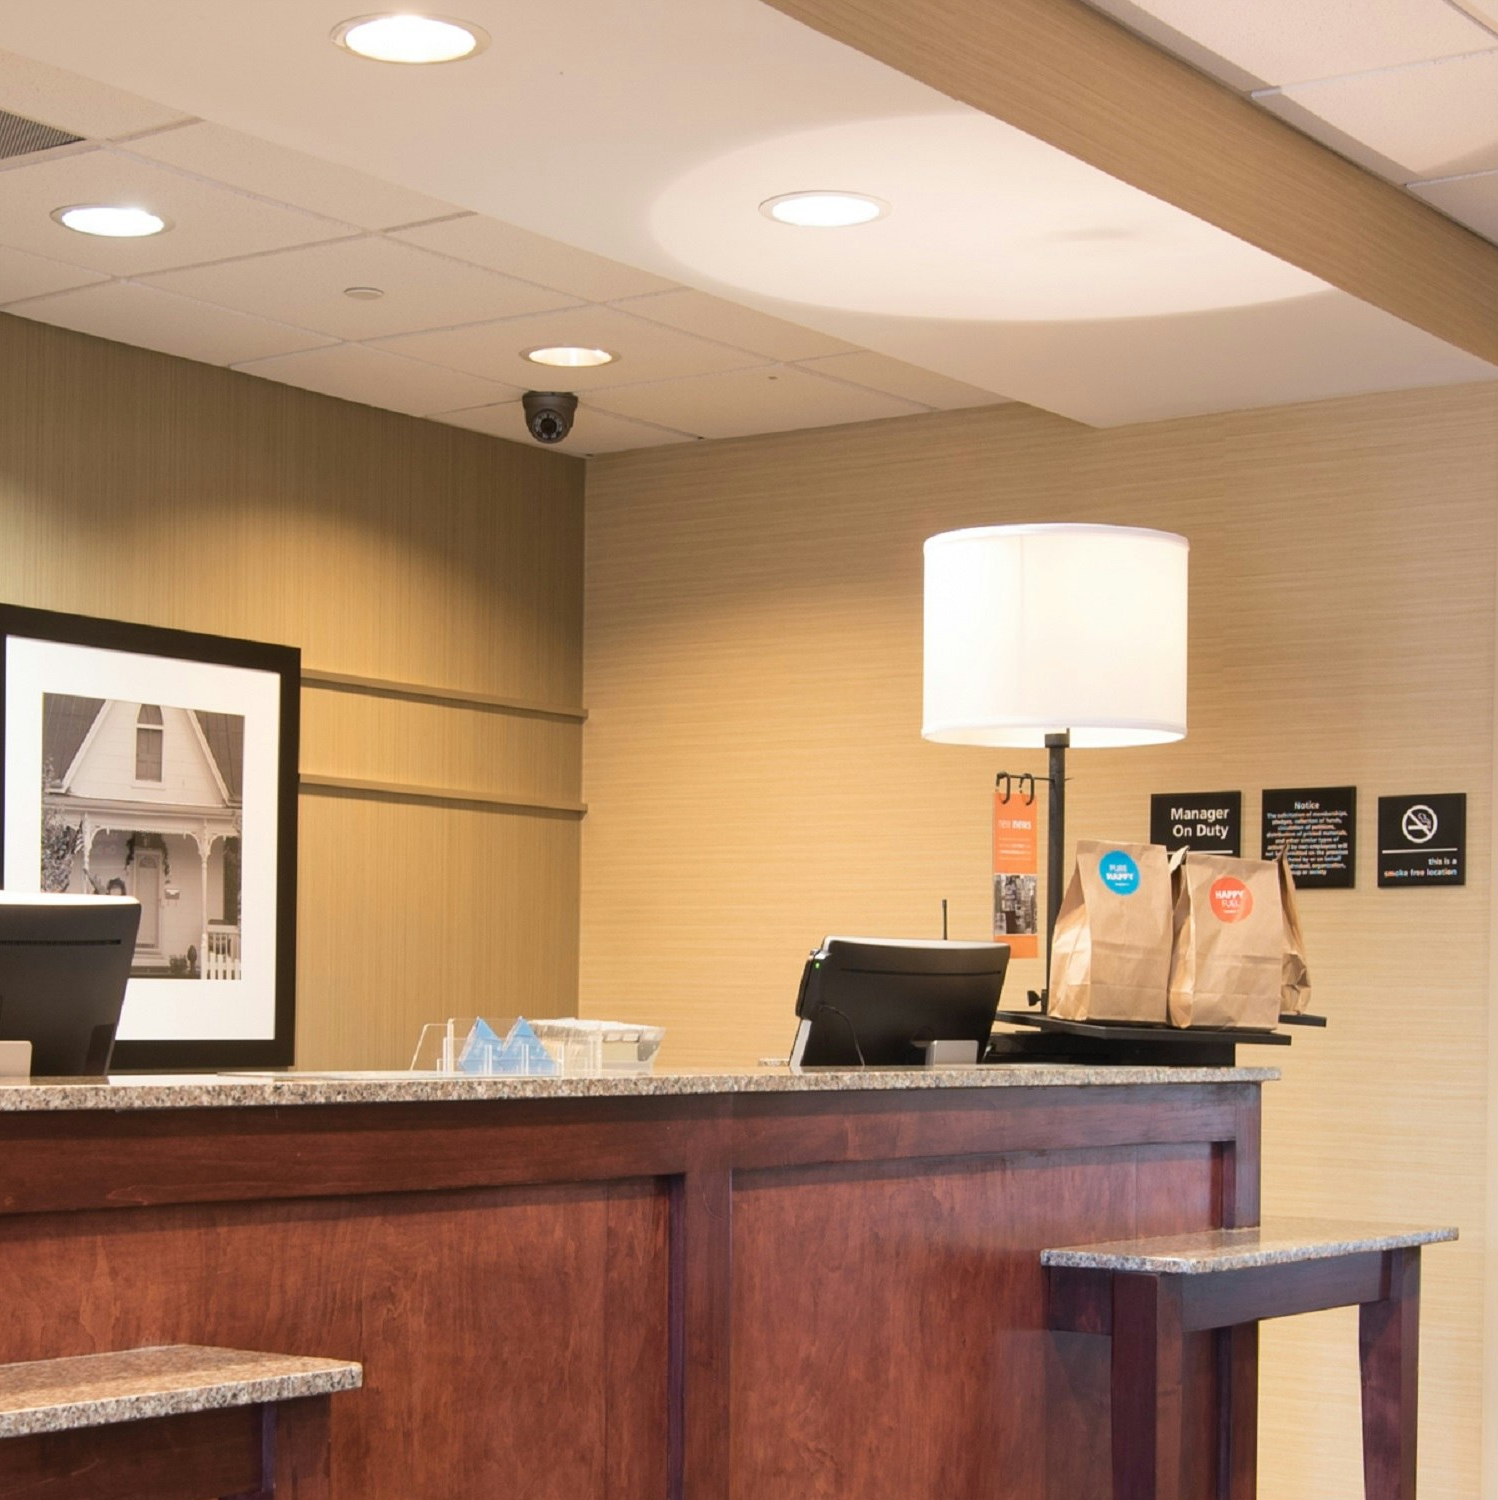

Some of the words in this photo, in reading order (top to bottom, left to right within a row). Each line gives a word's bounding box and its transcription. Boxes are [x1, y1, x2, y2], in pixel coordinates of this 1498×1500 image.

[1294, 800, 1320, 810] Notice
[1170, 807, 1230, 823] Manager
[1172, 824, 1192, 838] On
[1196, 824, 1229, 840] Duty
[1427, 857, 1443, 866] this
[1443, 857, 1450, 865] is
[1383, 869, 1409, 878] smoke
[1410, 868, 1425, 877] free
[1426, 868, 1458, 877] location
[1215, 889, 1244, 899] HAPPY
